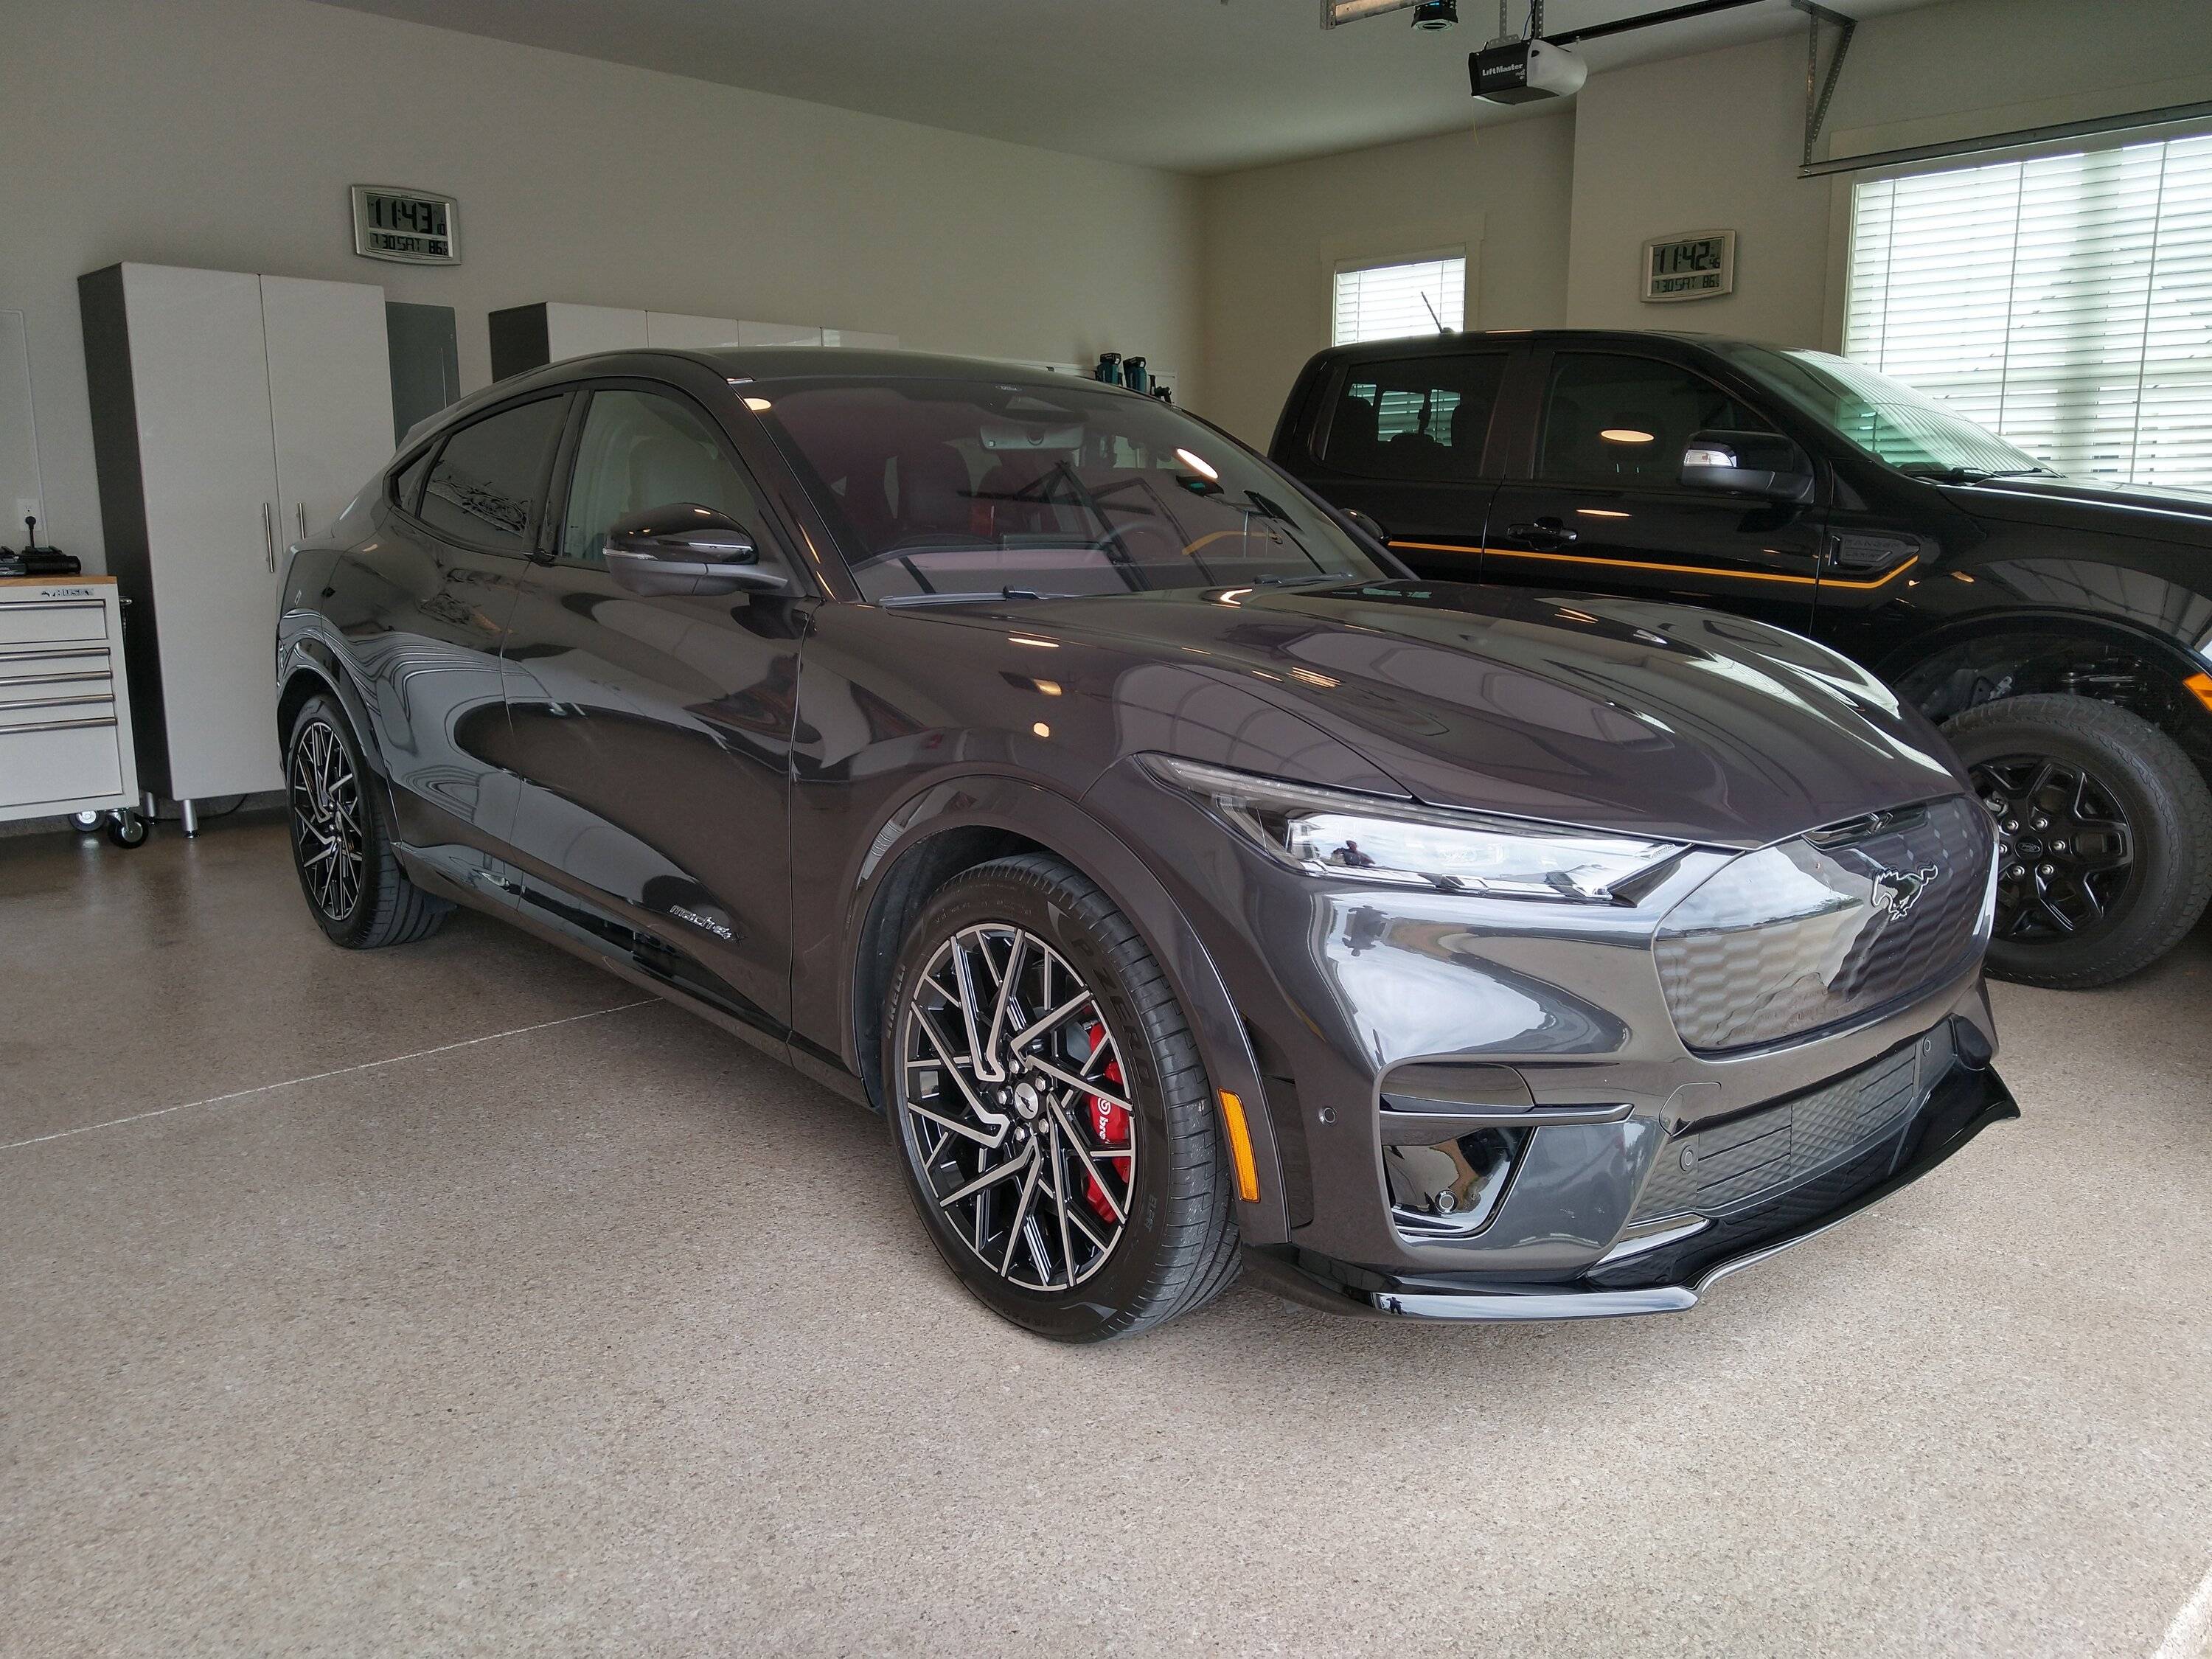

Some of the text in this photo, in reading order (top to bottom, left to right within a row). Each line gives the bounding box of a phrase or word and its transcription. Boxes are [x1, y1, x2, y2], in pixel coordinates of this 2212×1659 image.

[1482, 63, 1524, 76] LiftMaster
[375, 198, 433, 234] 11:43
[382, 234, 396, 250] 30
[397, 236, 421, 251] SAT
[1659, 241, 1711, 274] 11:42
[1662, 279, 1674, 293] 30
[1674, 276, 1697, 291] SAT
